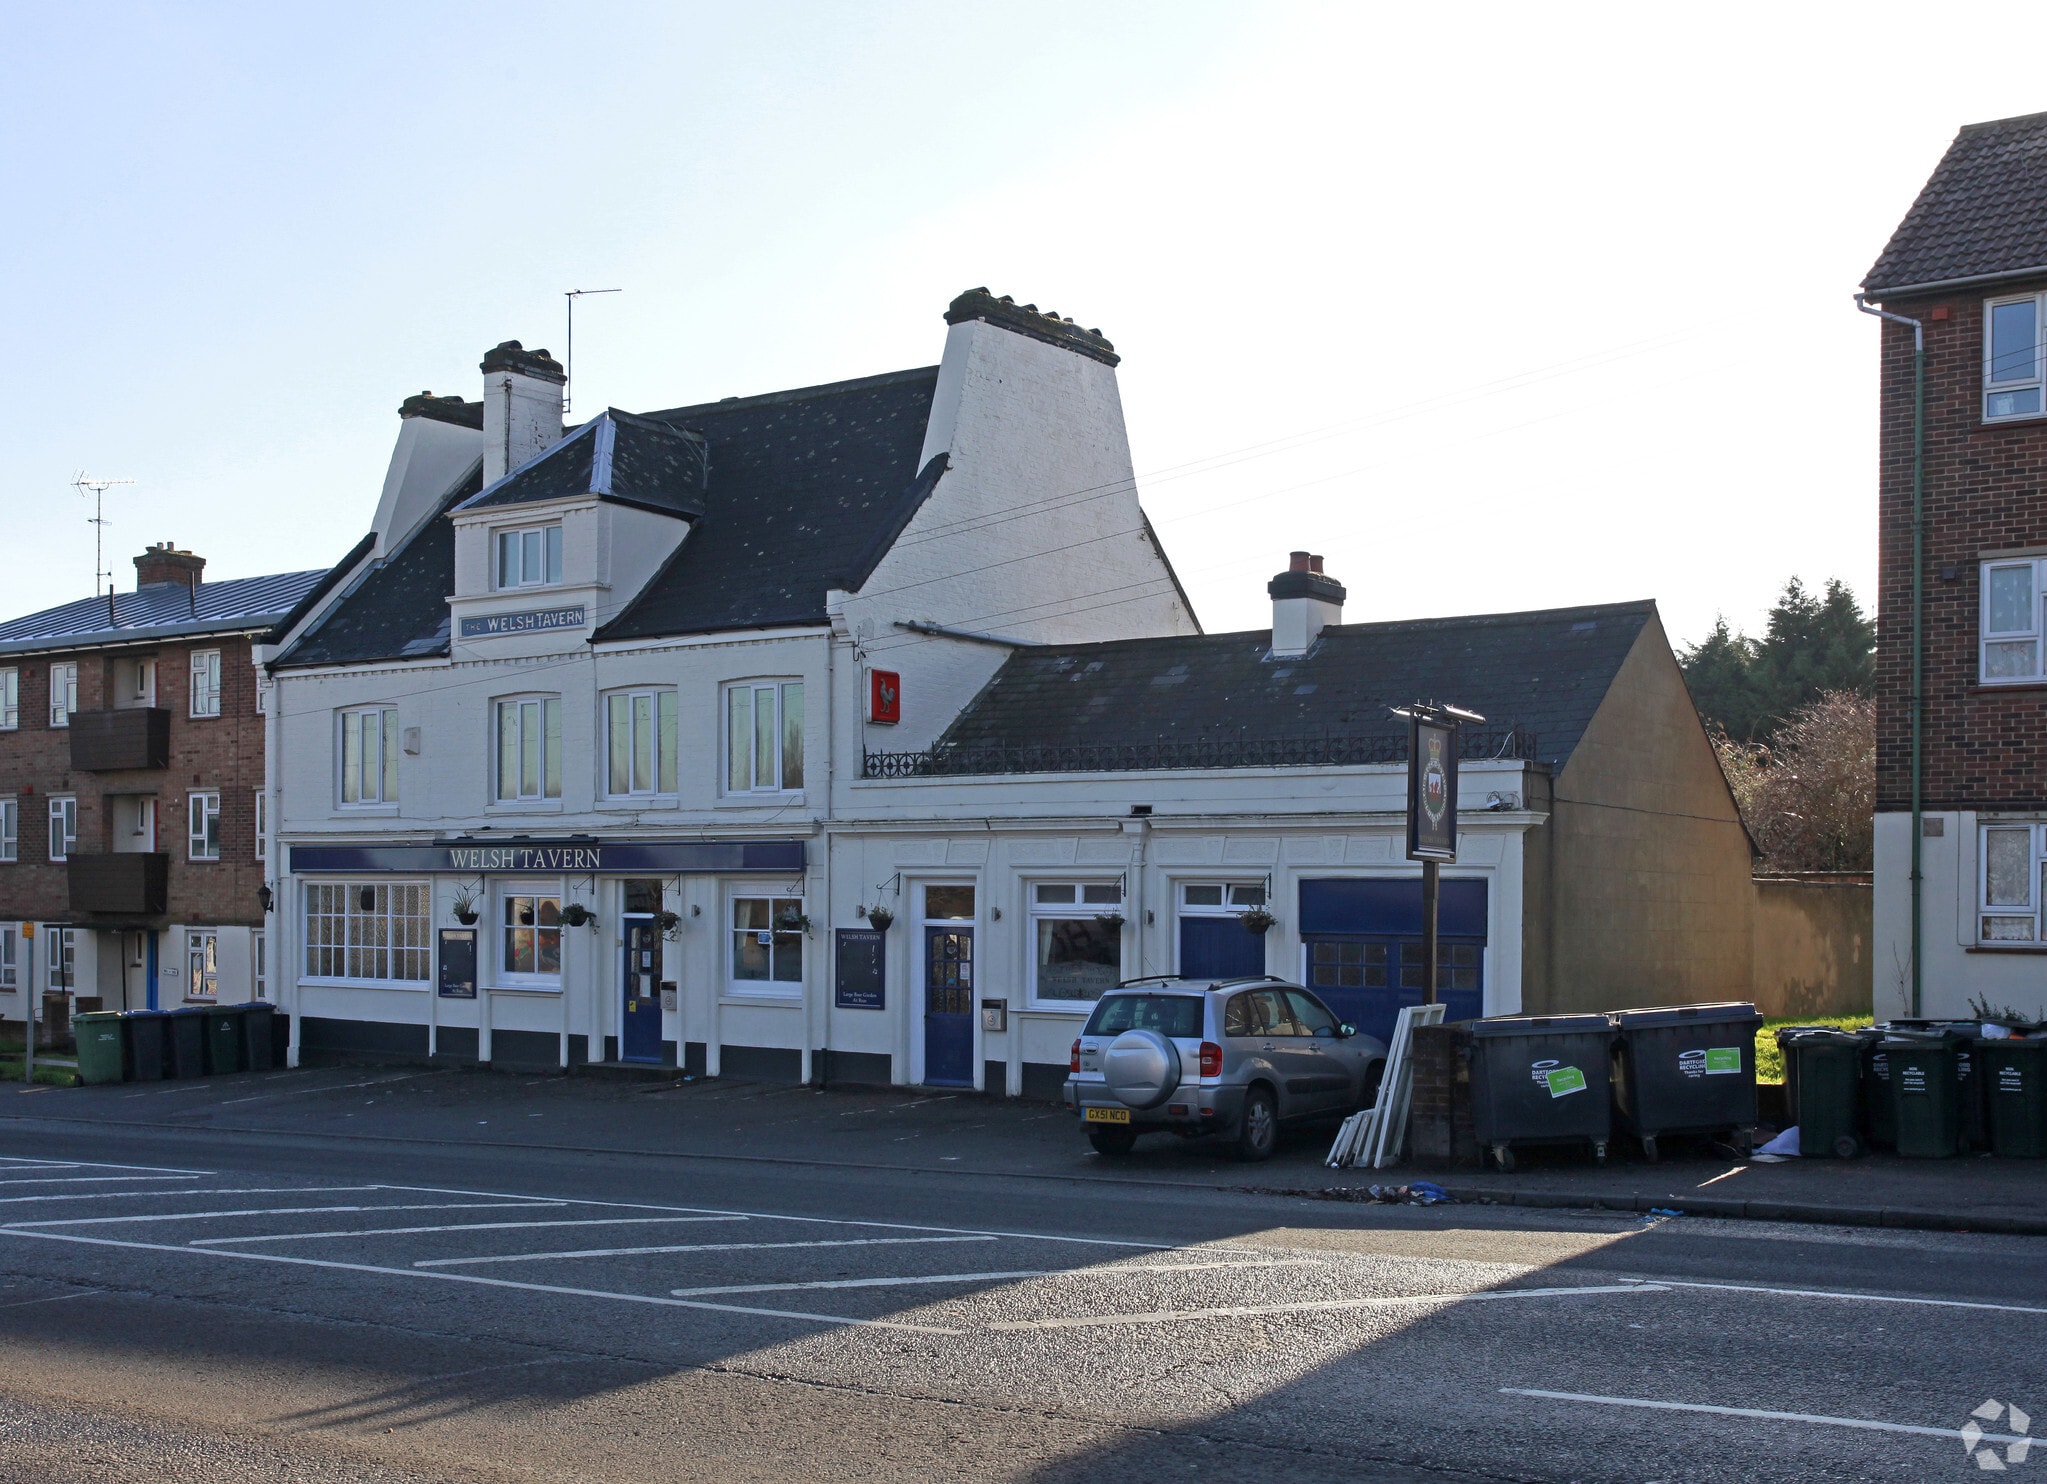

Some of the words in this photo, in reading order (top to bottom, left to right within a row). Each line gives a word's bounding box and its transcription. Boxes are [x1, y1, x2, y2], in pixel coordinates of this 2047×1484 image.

[465, 623, 481, 631] THE
[487, 615, 535, 632] WELSH
[536, 610, 583, 626] TAVERN
[450, 849, 514, 868] WELSH
[520, 848, 601, 868] TAVERN
[1089, 1109, 1108, 1120] GX51
[1110, 1110, 1126, 1121] NCO
